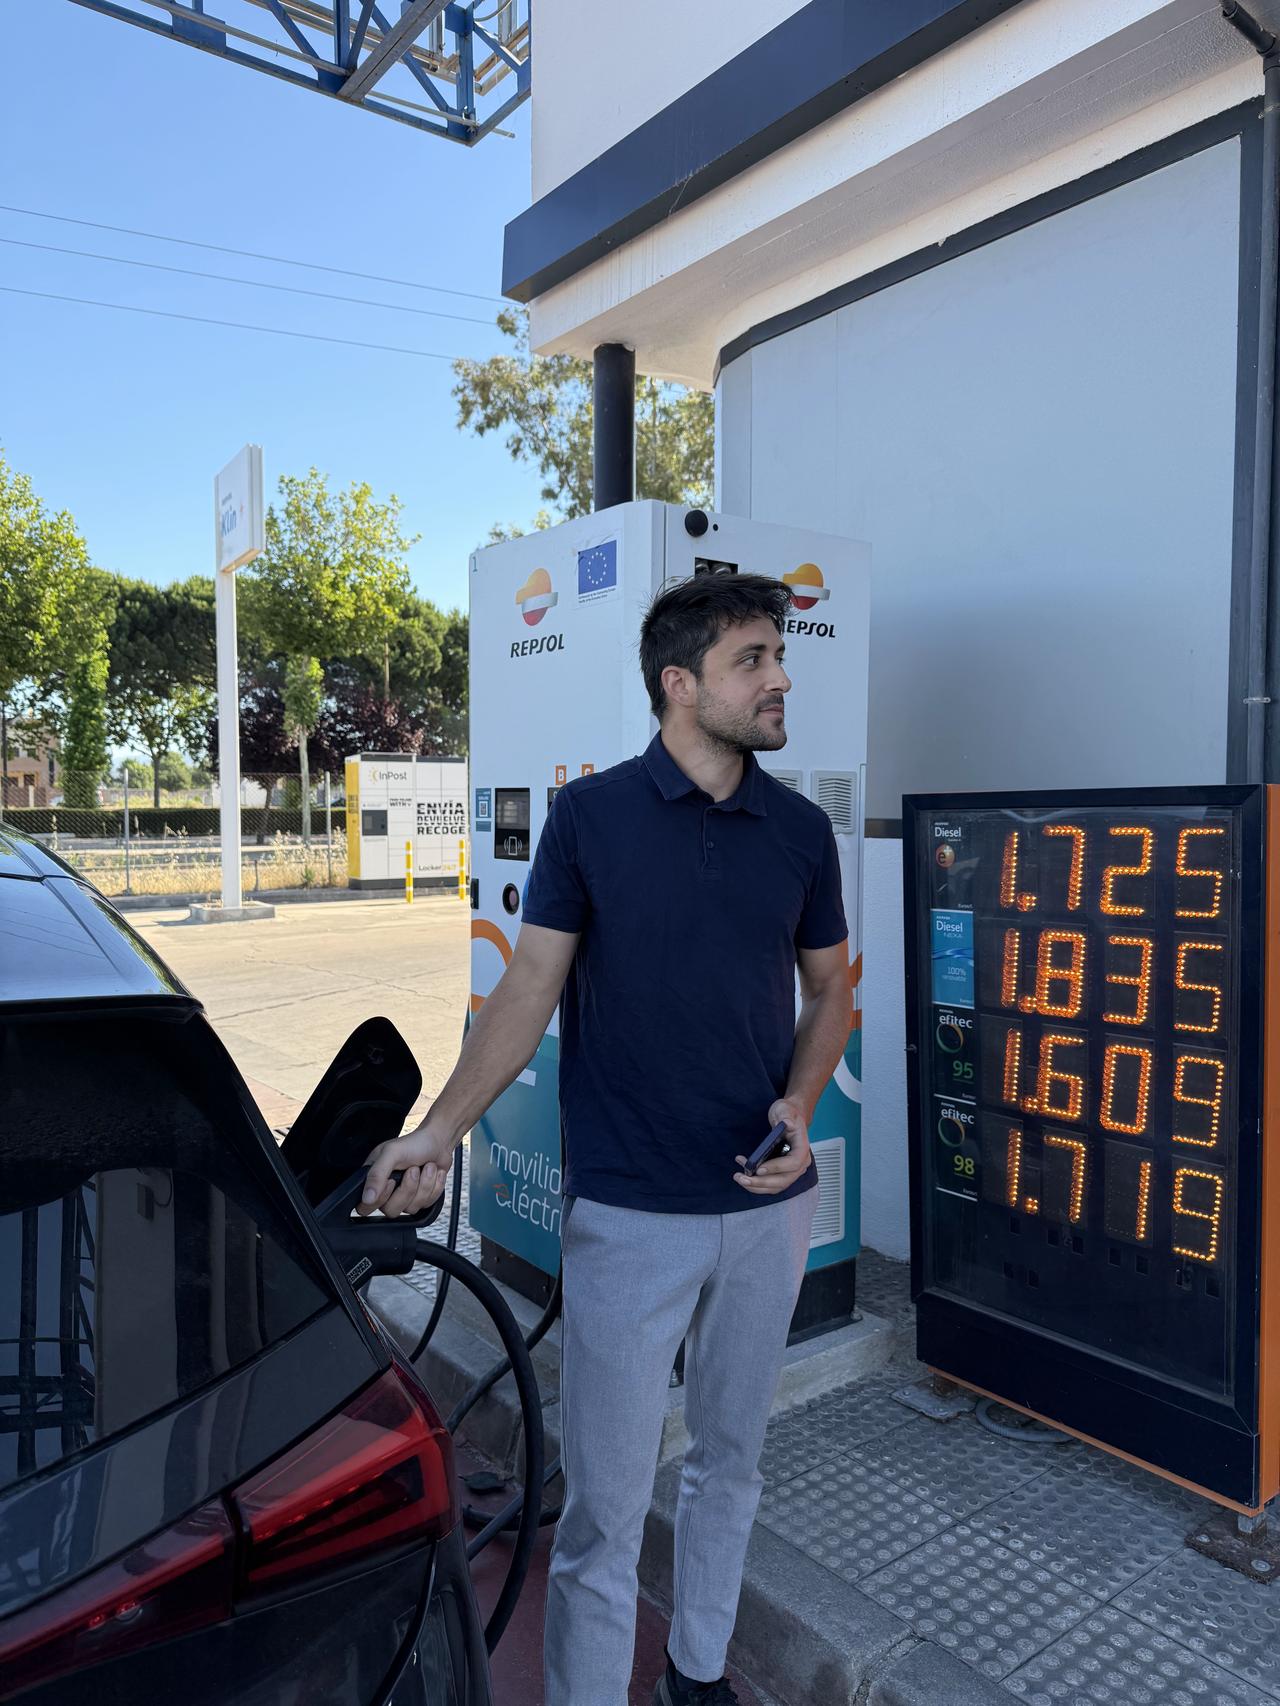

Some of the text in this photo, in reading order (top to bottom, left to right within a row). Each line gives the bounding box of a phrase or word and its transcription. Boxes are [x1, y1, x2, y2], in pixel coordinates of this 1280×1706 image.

[782, 619, 836, 638] EPSOL
[510, 633, 565, 658] REPSOL
[379, 771, 407, 780] InPost
[557, 769, 565, 782] B
[417, 815, 466, 826] DEVUELVE
[417, 826, 466, 835] RECOGE
[934, 827, 962, 837] Diesel
[1000, 825, 1225, 918] 1.725
[936, 920, 963, 933] Diesel
[1001, 928, 1224, 1034] 1.835
[939, 1014, 973, 1029] efitec
[953, 1060, 974, 1079] 95
[1003, 1029, 1225, 1149] 1.609
[941, 1108, 975, 1125] efitec
[954, 1154, 975, 1175] 98
[1009, 1129, 1224, 1262] 1.719
